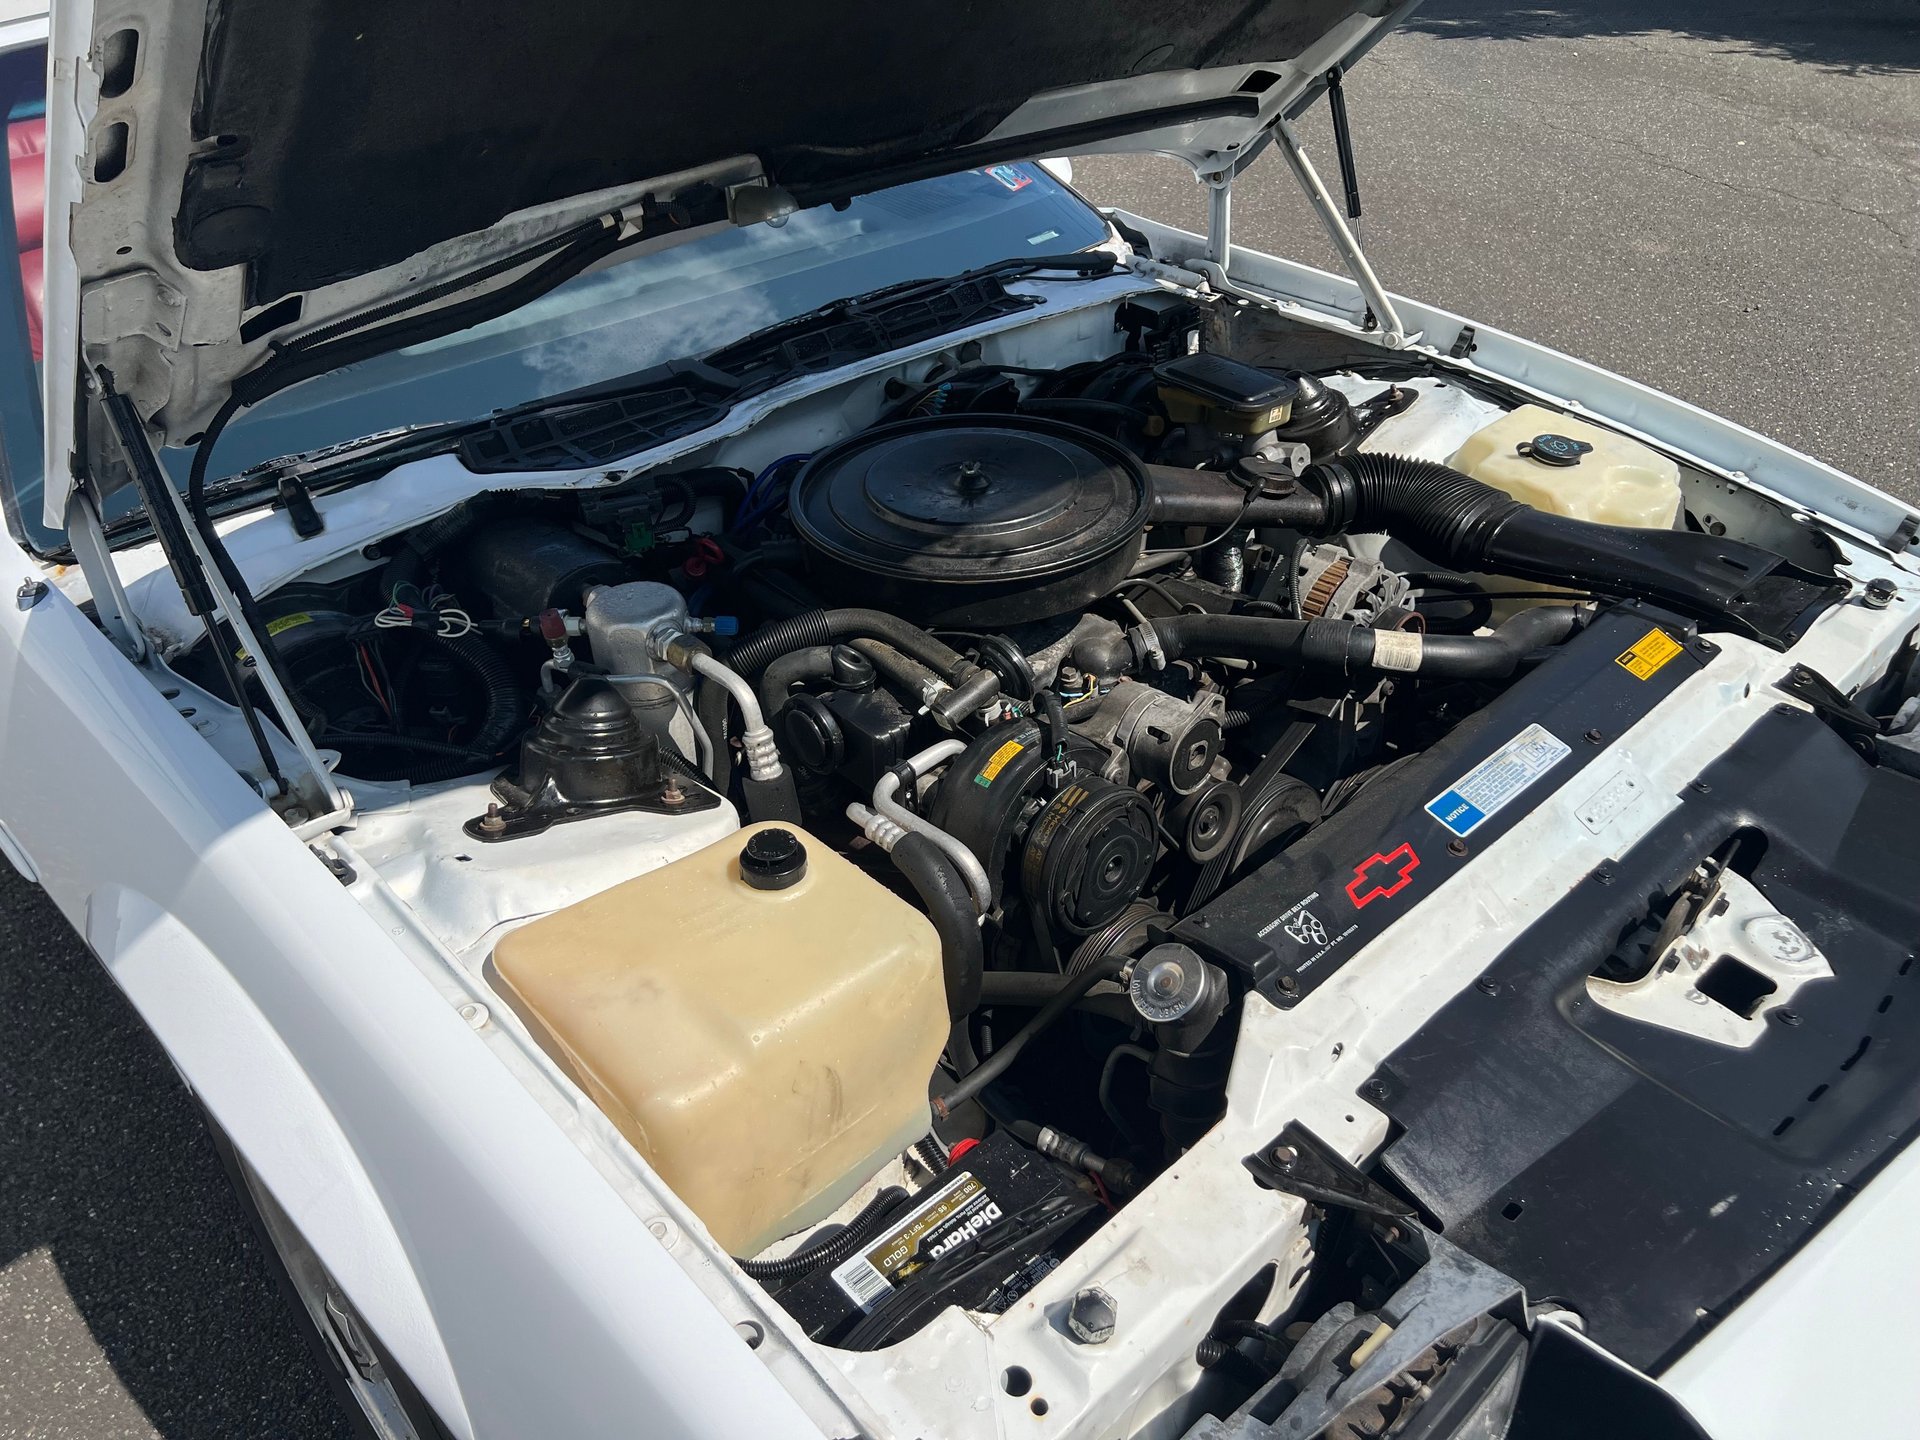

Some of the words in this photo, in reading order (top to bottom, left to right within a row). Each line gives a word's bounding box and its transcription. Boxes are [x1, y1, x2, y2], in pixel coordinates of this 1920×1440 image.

[1446, 803, 1469, 822] NOTICE
[1257, 918, 1281, 938] ACCESSORY
[1280, 910, 1293, 921] DRIVE
[1291, 903, 1302, 913] BELT
[1300, 892, 1319, 906] ROUTING
[1132, 979, 1141, 995] HOT
[1135, 998, 1155, 1016] OPEN
[1159, 1000, 1187, 1018] NEVER
[963, 1182, 976, 1193] 700
[938, 1205, 947, 1213] 95
[883, 1245, 908, 1267] GOLD
